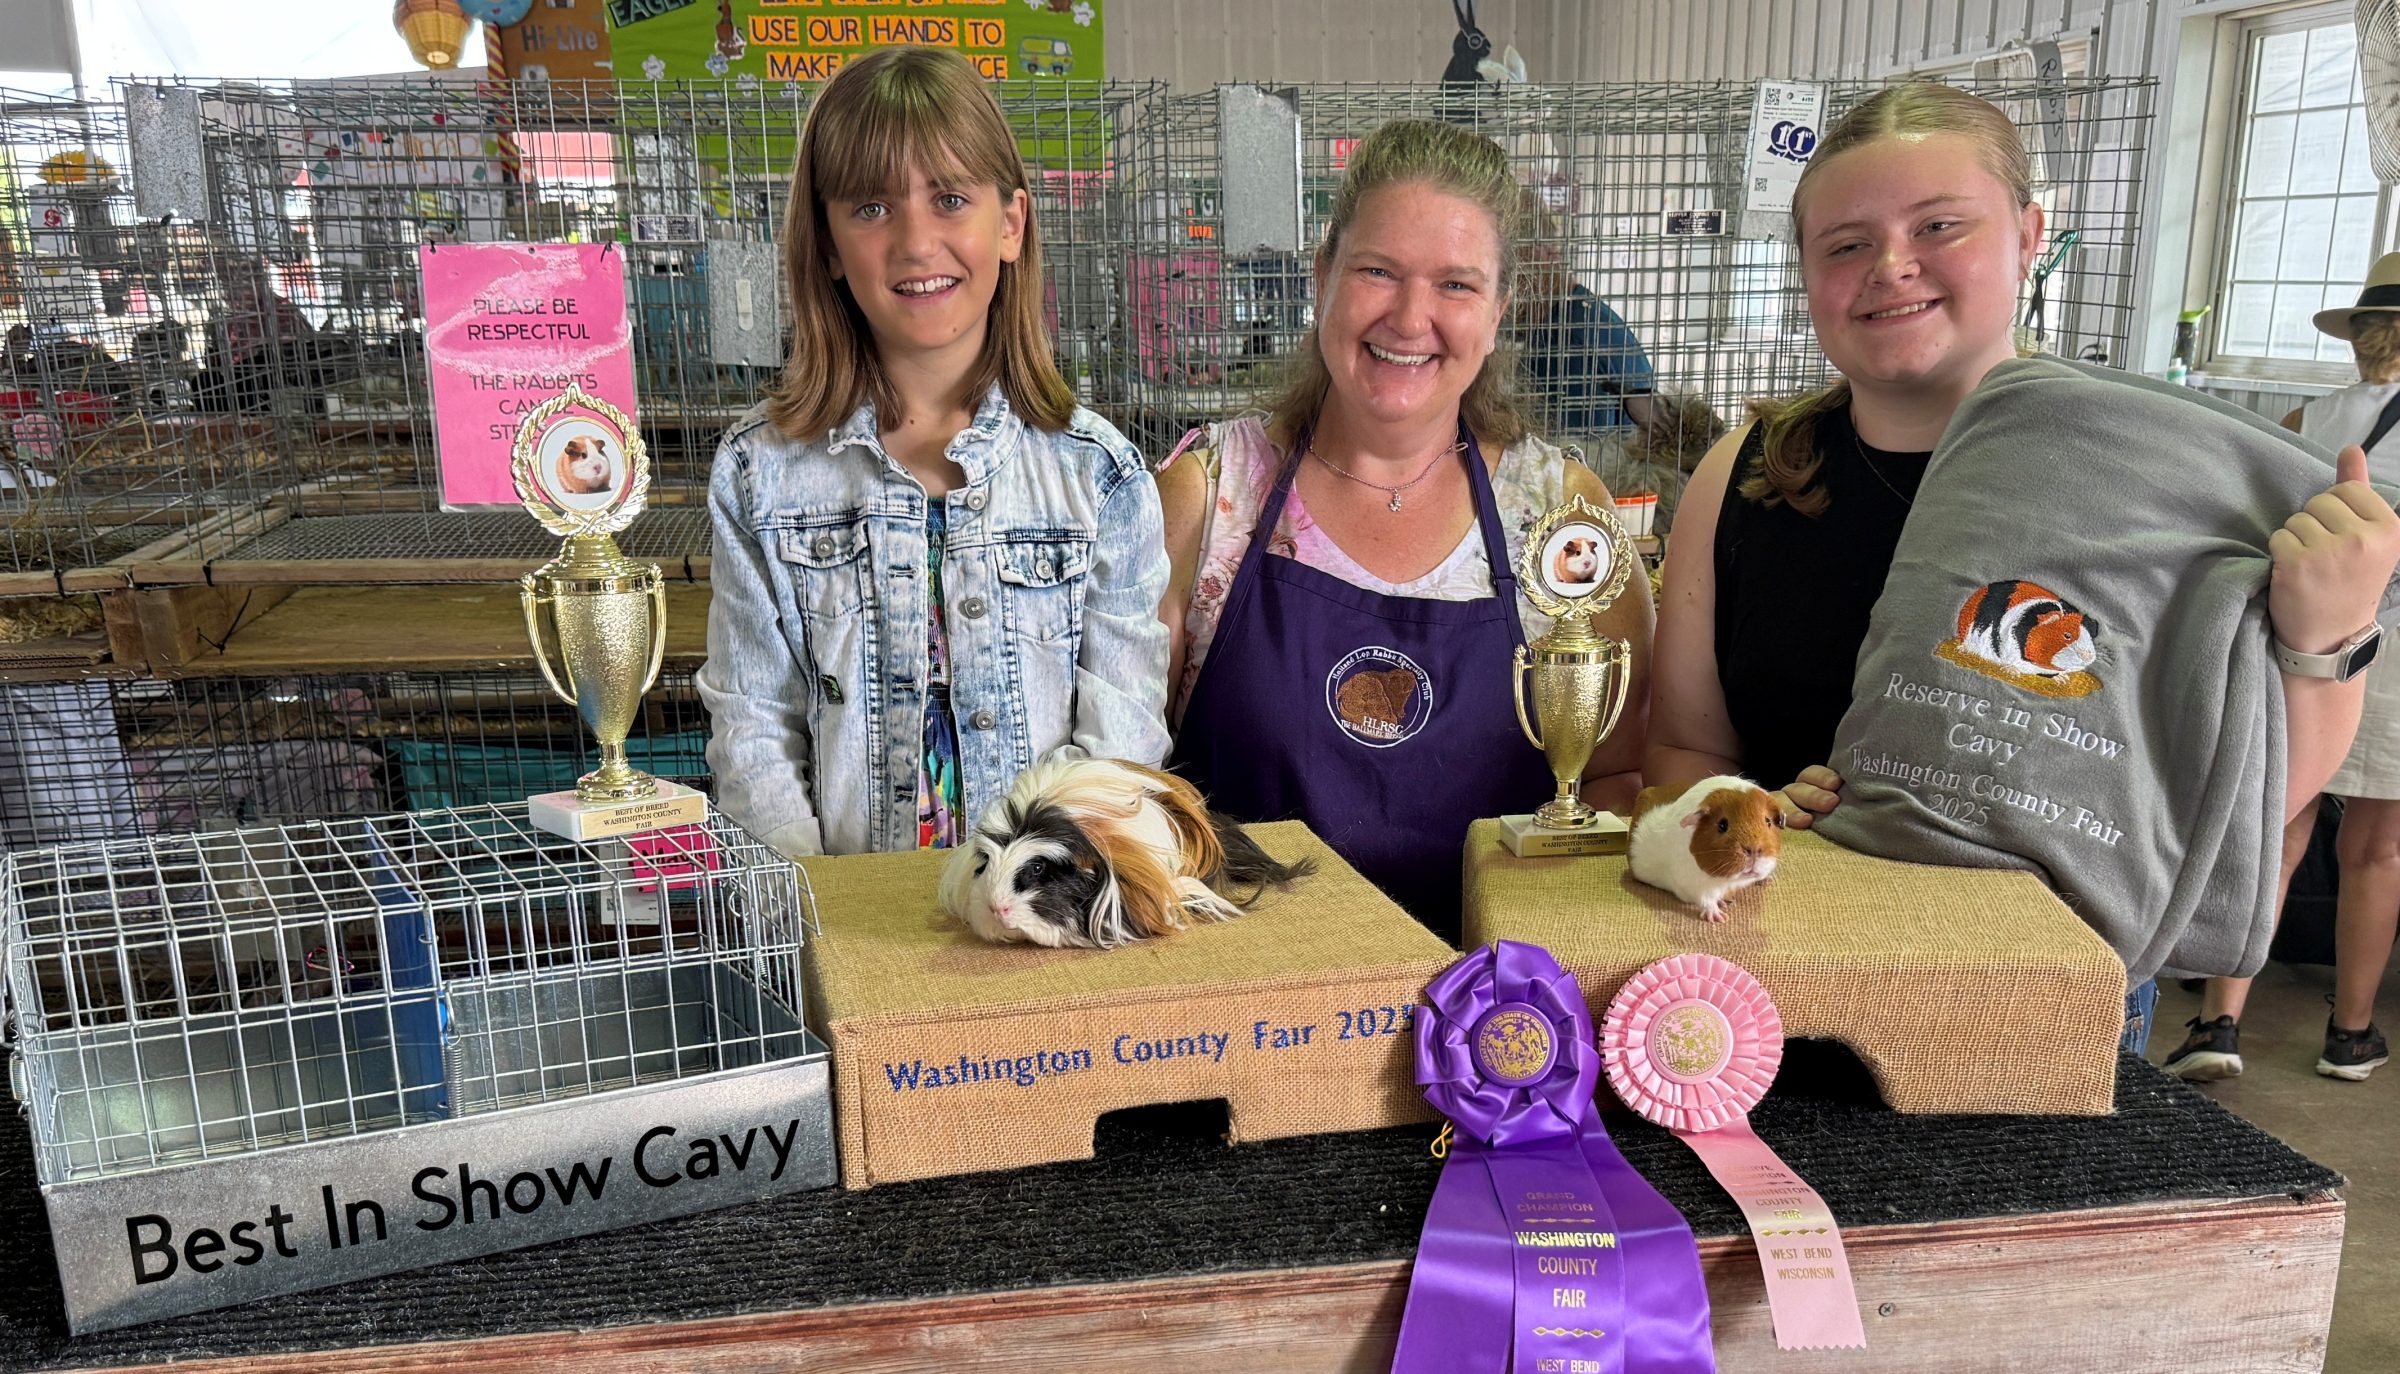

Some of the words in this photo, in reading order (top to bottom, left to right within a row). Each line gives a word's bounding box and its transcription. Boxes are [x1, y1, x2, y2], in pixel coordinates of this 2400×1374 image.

[752, 19, 797, 42] USE
[809, 19, 860, 42] OUR
[874, 20, 954, 43] HANDS
[969, 22, 1002, 46] TO
[769, 54, 839, 79] MAKE
[473, 298, 546, 315] PLEASE
[553, 298, 578, 315] BE
[467, 324, 590, 341] RESPECTFUL
[469, 374, 508, 391] THE
[1421, 682, 1431, 701] Club
[1363, 715, 1404, 735] HLRSC
[1883, 672, 1991, 717] Reserve
[1999, 700, 2032, 729] in
[2043, 712, 2125, 761] Show
[1948, 722, 2023, 766] Cavy
[1851, 748, 1961, 790] Washington
[1970, 774, 2068, 824] County
[2069, 805, 2125, 847] Fair
[603, 813, 652, 826] WASHINGTON
[652, 807, 682, 819] COUNTY
[615, 808, 634, 817] BEST
[634, 805, 644, 814] OF
[645, 802, 669, 812] BREED
[1928, 792, 1992, 829] 2025
[636, 821, 653, 830] FAIR
[884, 1044, 1092, 1094] Washington
[1112, 1030, 1230, 1066] County
[1253, 1020, 1317, 1051] Fair
[125, 1204, 300, 1286] Best
[322, 1184, 388, 1251] In
[409, 1156, 612, 1233] Show
[632, 1118, 800, 1190] Cavy
[1527, 1192, 1575, 1200] GRAND
[1755, 1197, 1803, 1207] COUNTY
[1516, 1203, 1594, 1212] CHAMPION
[1515, 1232, 1615, 1248] WASHINGTON
[1771, 1248, 1798, 1259] WEST
[1804, 1247, 1832, 1259] BEND
[1538, 1256, 1597, 1276] COUNTY
[1777, 1267, 1835, 1280] WISCONSIN
[1553, 1288, 1586, 1308] FAIR
[1536, 1359, 1565, 1372] WEST
[1571, 1359, 1600, 1374] BEND
